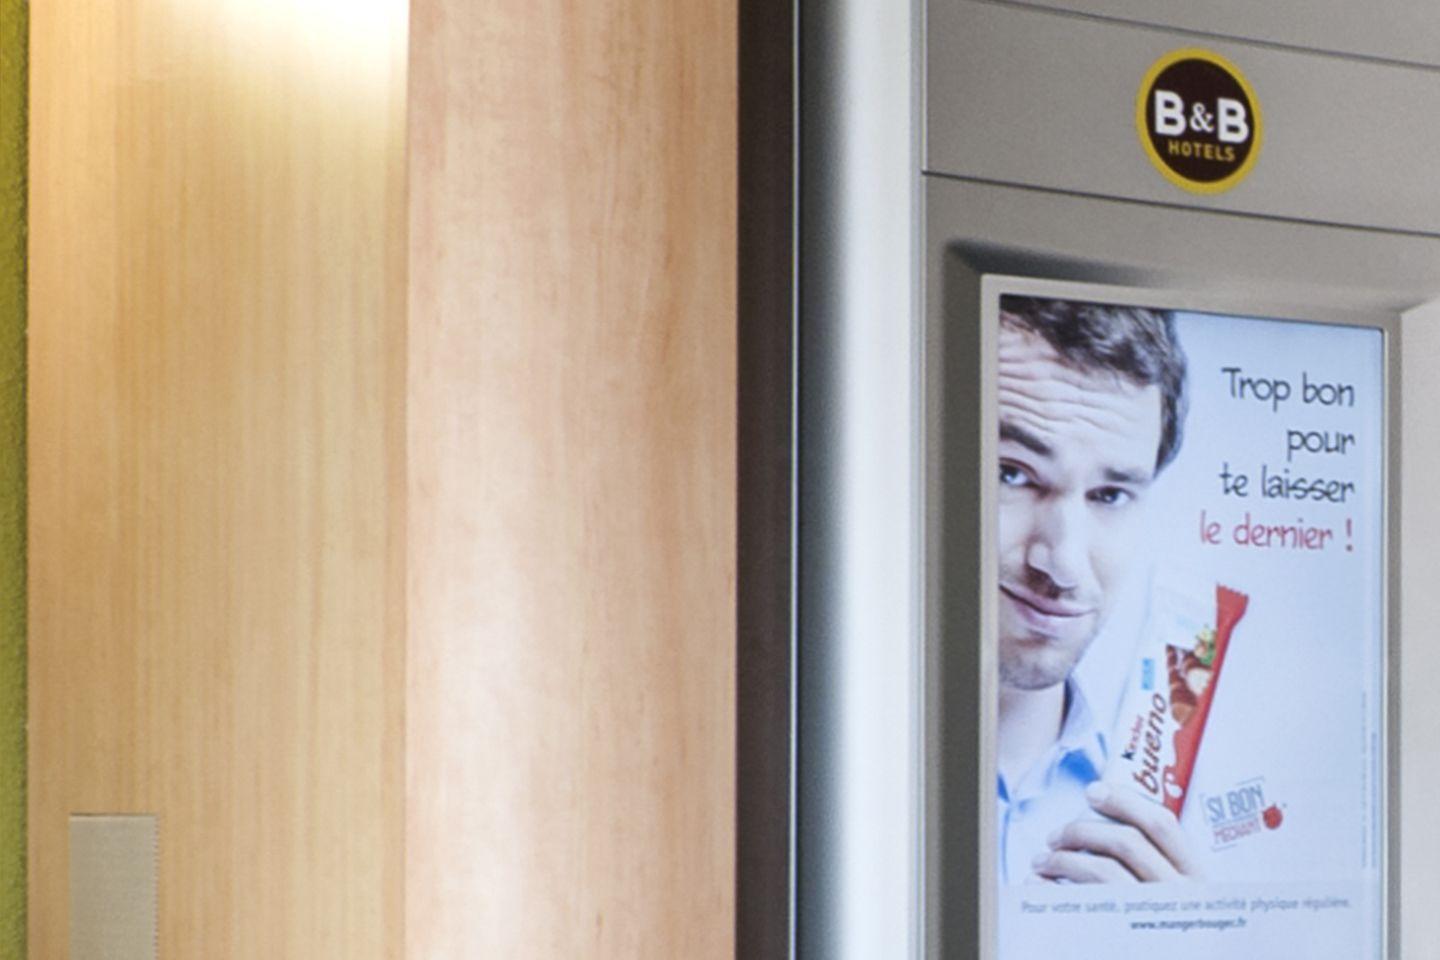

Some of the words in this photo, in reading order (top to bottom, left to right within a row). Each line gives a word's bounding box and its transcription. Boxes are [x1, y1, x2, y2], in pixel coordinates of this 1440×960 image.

[1155, 90, 1249, 144] B&B
[1168, 139, 1236, 162] HOTELS
[1221, 367, 1291, 412] Trop
[1302, 371, 1355, 407] bon
[1287, 429, 1355, 462] pour
[1219, 462, 1249, 497] te
[1262, 464, 1355, 502] laisser
[1200, 510, 1221, 545] le
[1233, 512, 1333, 550] dernier
[1133, 693, 1167, 795] bueno
[1228, 784, 1265, 818] BON
